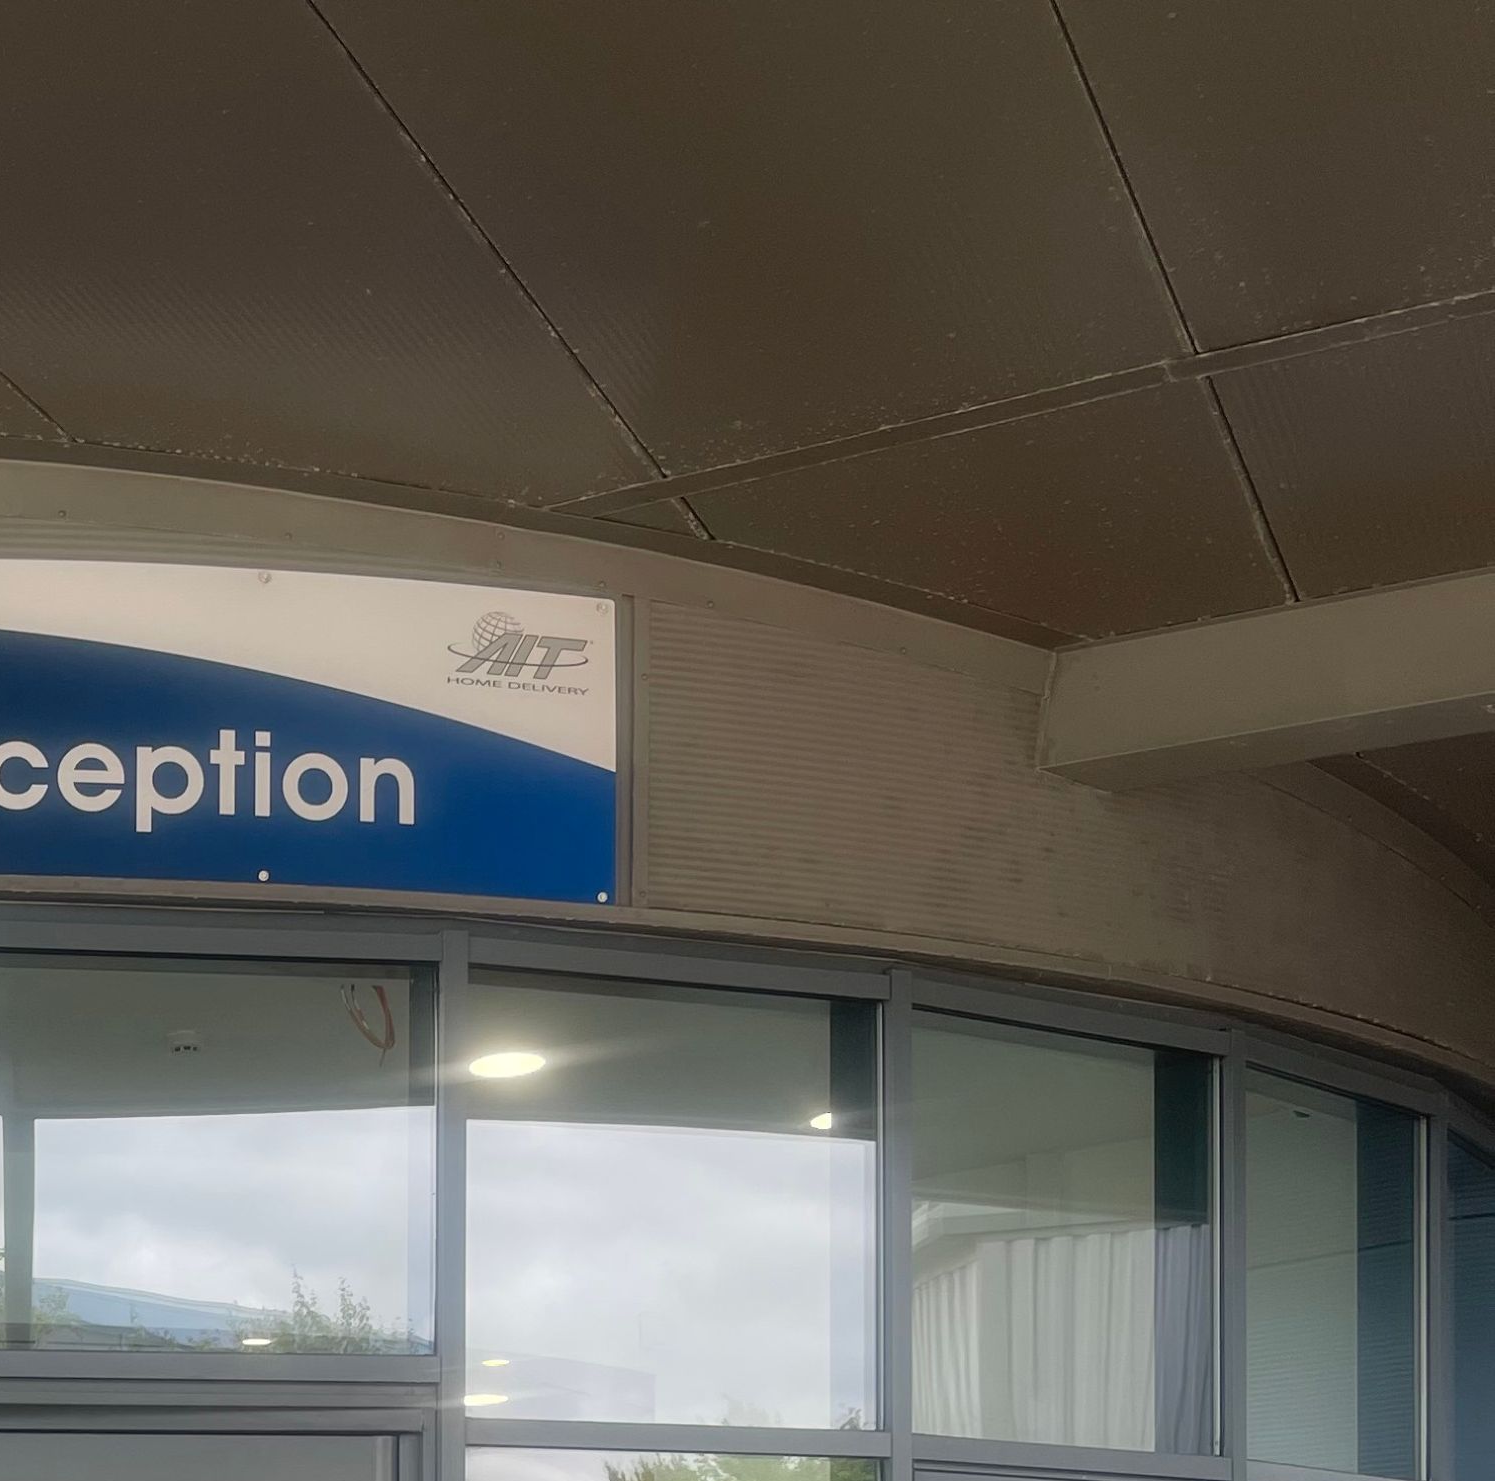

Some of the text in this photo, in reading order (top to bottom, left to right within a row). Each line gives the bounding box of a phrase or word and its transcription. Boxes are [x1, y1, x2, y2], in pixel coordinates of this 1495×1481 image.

[455, 632, 588, 680] AIT
[447, 676, 589, 696] HOME DELIVERY
